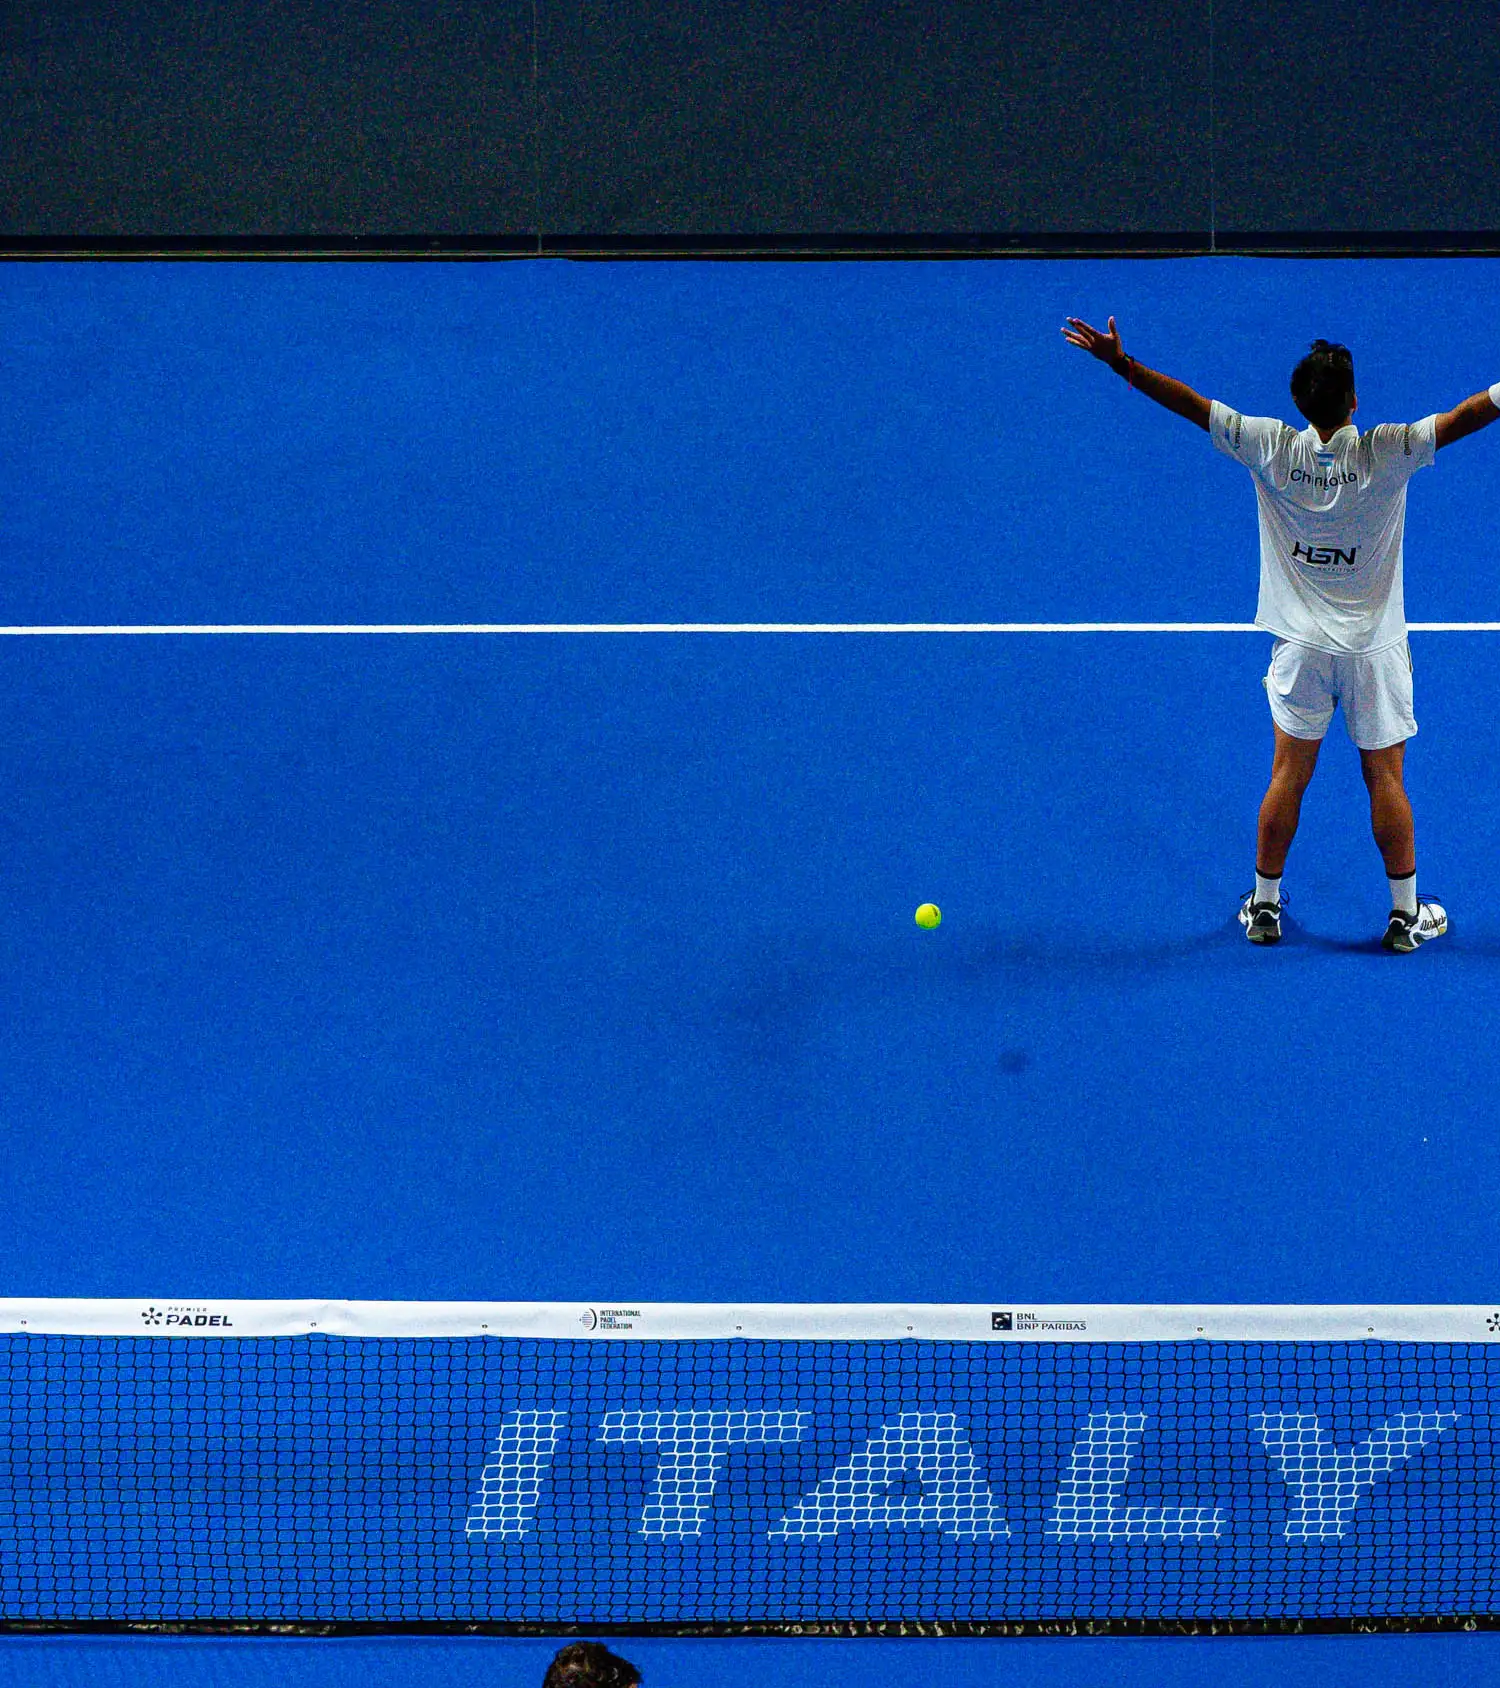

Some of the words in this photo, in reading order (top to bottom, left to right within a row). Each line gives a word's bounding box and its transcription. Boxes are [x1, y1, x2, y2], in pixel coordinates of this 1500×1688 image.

[1291, 541, 1357, 566] HSN
[165, 1314, 233, 1327] PADEL
[1016, 1312, 1037, 1320] BNL
[1016, 1322, 1039, 1331] BNP
[1041, 1322, 1087, 1331] PARIBAS
[464, 1408, 1463, 1542] ITALY
